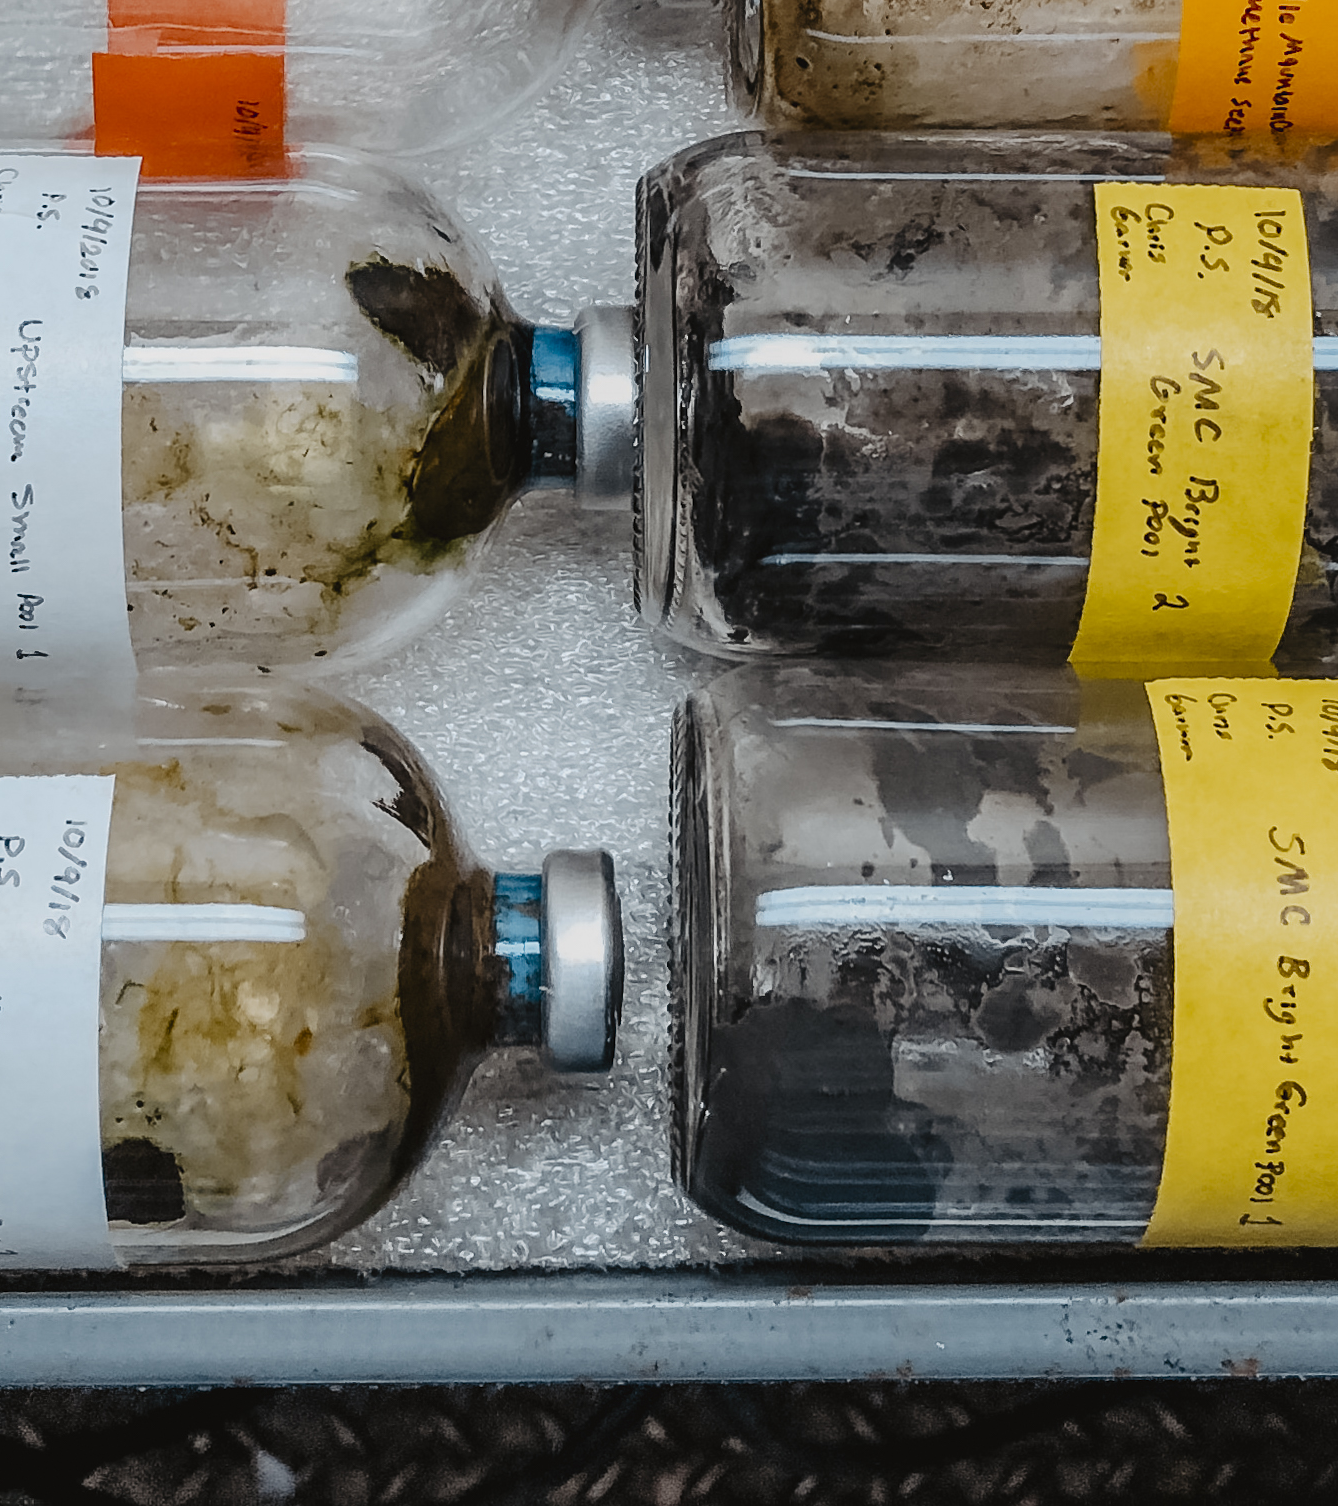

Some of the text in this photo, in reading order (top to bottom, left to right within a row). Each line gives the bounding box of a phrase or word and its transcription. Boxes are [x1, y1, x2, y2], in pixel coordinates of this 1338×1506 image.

[75, 185, 113, 301] 10/9/2018
[1144, 202, 1175, 265] Chris
[1193, 220, 1234, 280] P.S.
[1250, 208, 1289, 319] 10/9/18
[1147, 374, 1182, 477] Green
[1189, 346, 1226, 444] SMC
[9, 482, 35, 574] Small
[16, 591, 45, 631] Pool
[1151, 591, 1191, 613] 2
[1260, 701, 1296, 741] P.S.
[41, 818, 88, 940] 10/9/18
[1267, 824, 1313, 929] SMC
[1262, 953, 1313, 1065] Bright
[1264, 1079, 1309, 1168] Green
[1239, 1212, 1284, 1229] 1
